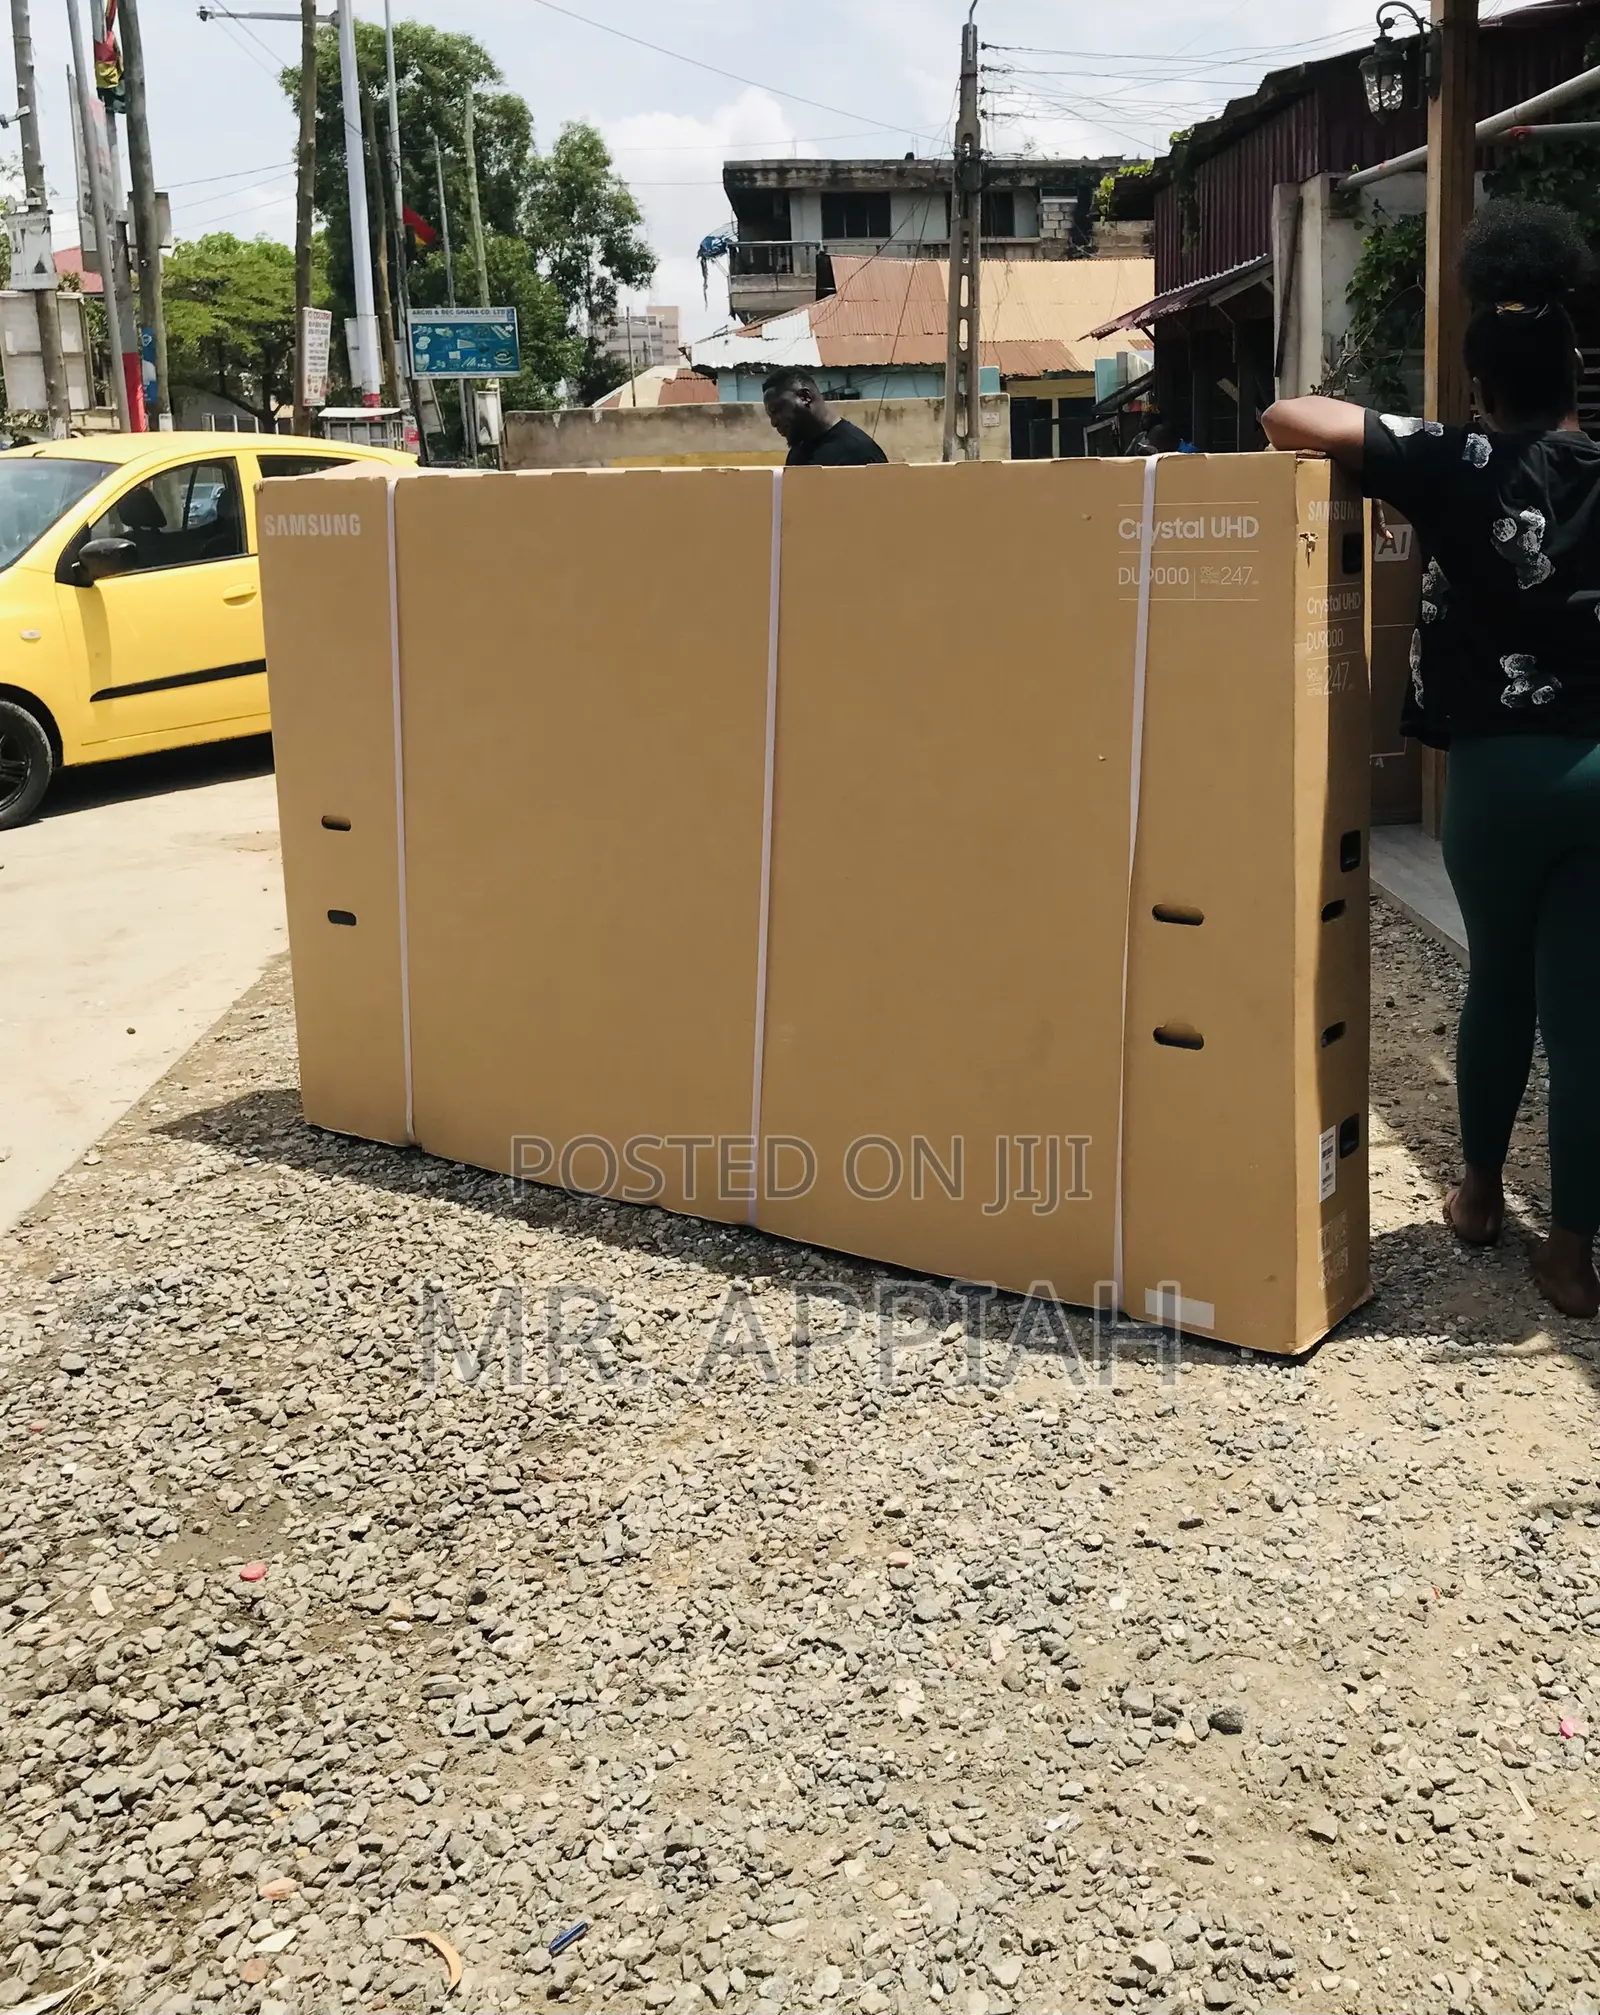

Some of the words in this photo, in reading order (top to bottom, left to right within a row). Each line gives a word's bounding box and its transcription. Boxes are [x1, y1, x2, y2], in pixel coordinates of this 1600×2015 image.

[1307, 500, 1361, 521] SAMSUNG
[263, 513, 361, 536] SAMSUNG
[1118, 516, 1205, 547] Crystal
[1211, 515, 1259, 538] UHD
[1378, 532, 1407, 555] AI
[1220, 566, 1253, 585] 247
[1306, 594, 1341, 620] Crystal
[1342, 592, 1360, 610] UHD
[1306, 628, 1344, 651] DU9000
[1323, 661, 1350, 696] 247
